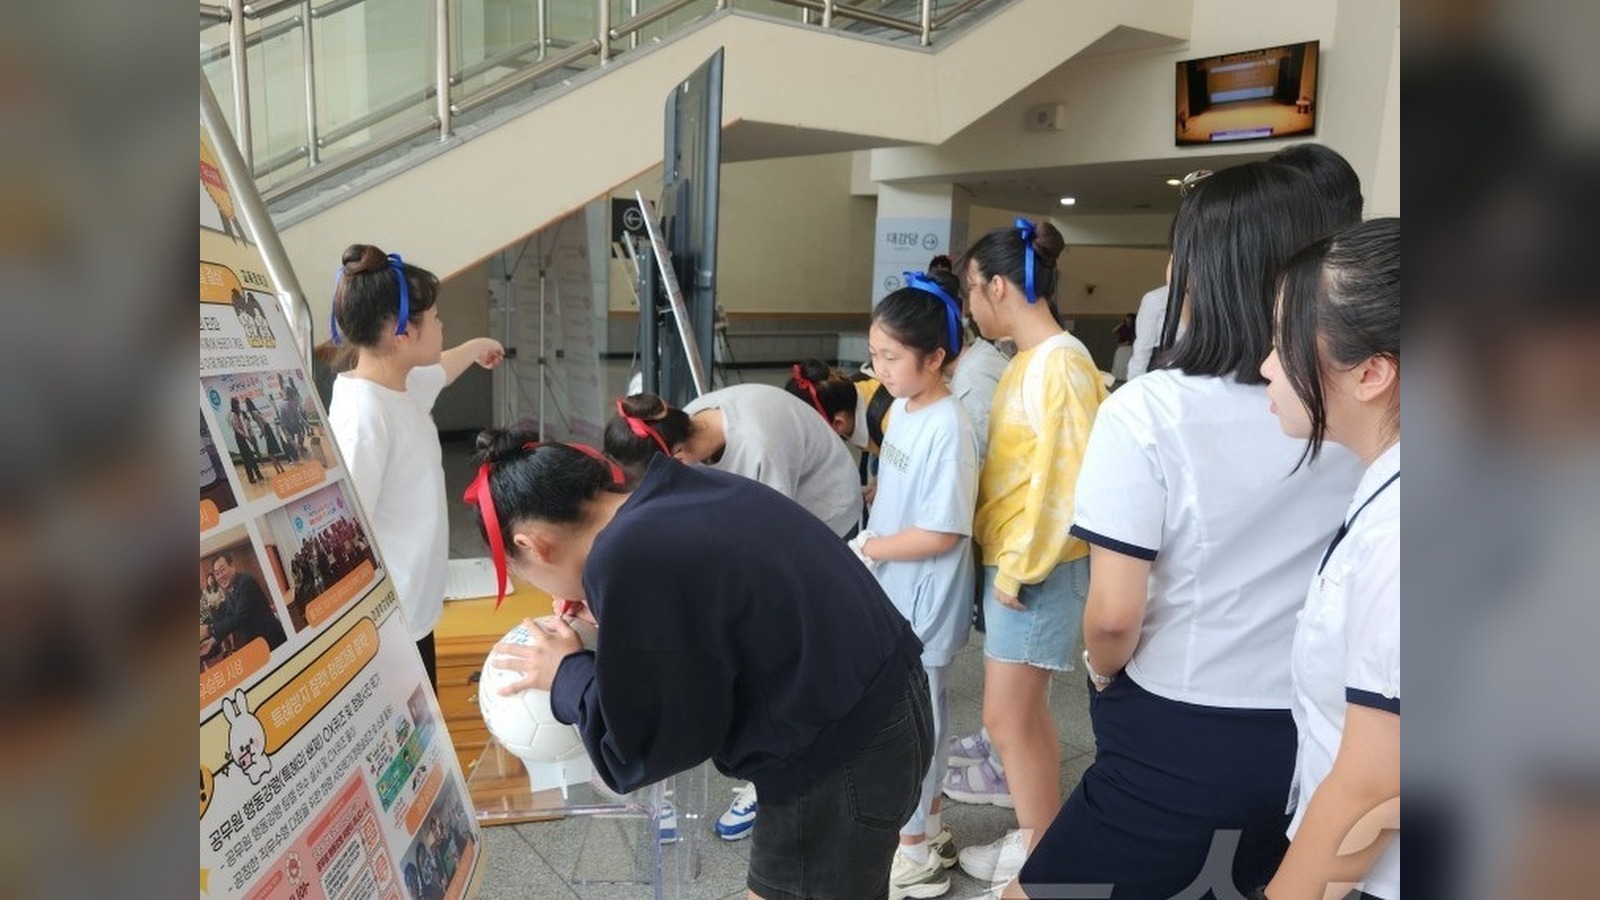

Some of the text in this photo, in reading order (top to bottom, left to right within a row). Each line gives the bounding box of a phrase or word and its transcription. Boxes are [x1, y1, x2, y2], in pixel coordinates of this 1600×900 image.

[886, 231, 919, 247] 대강당
[226, 658, 243, 681] 시상
[209, 810, 245, 852] 공무원
[225, 834, 253, 867] 공무원
[250, 803, 283, 842] 행동강령
[296, 777, 310, 797] 연수
[310, 762, 323, 783] 실시
[233, 855, 260, 890] 공정한
[258, 824, 290, 859] 직무수행
[288, 802, 310, 831] 다짐을
[308, 788, 322, 809] 위한
